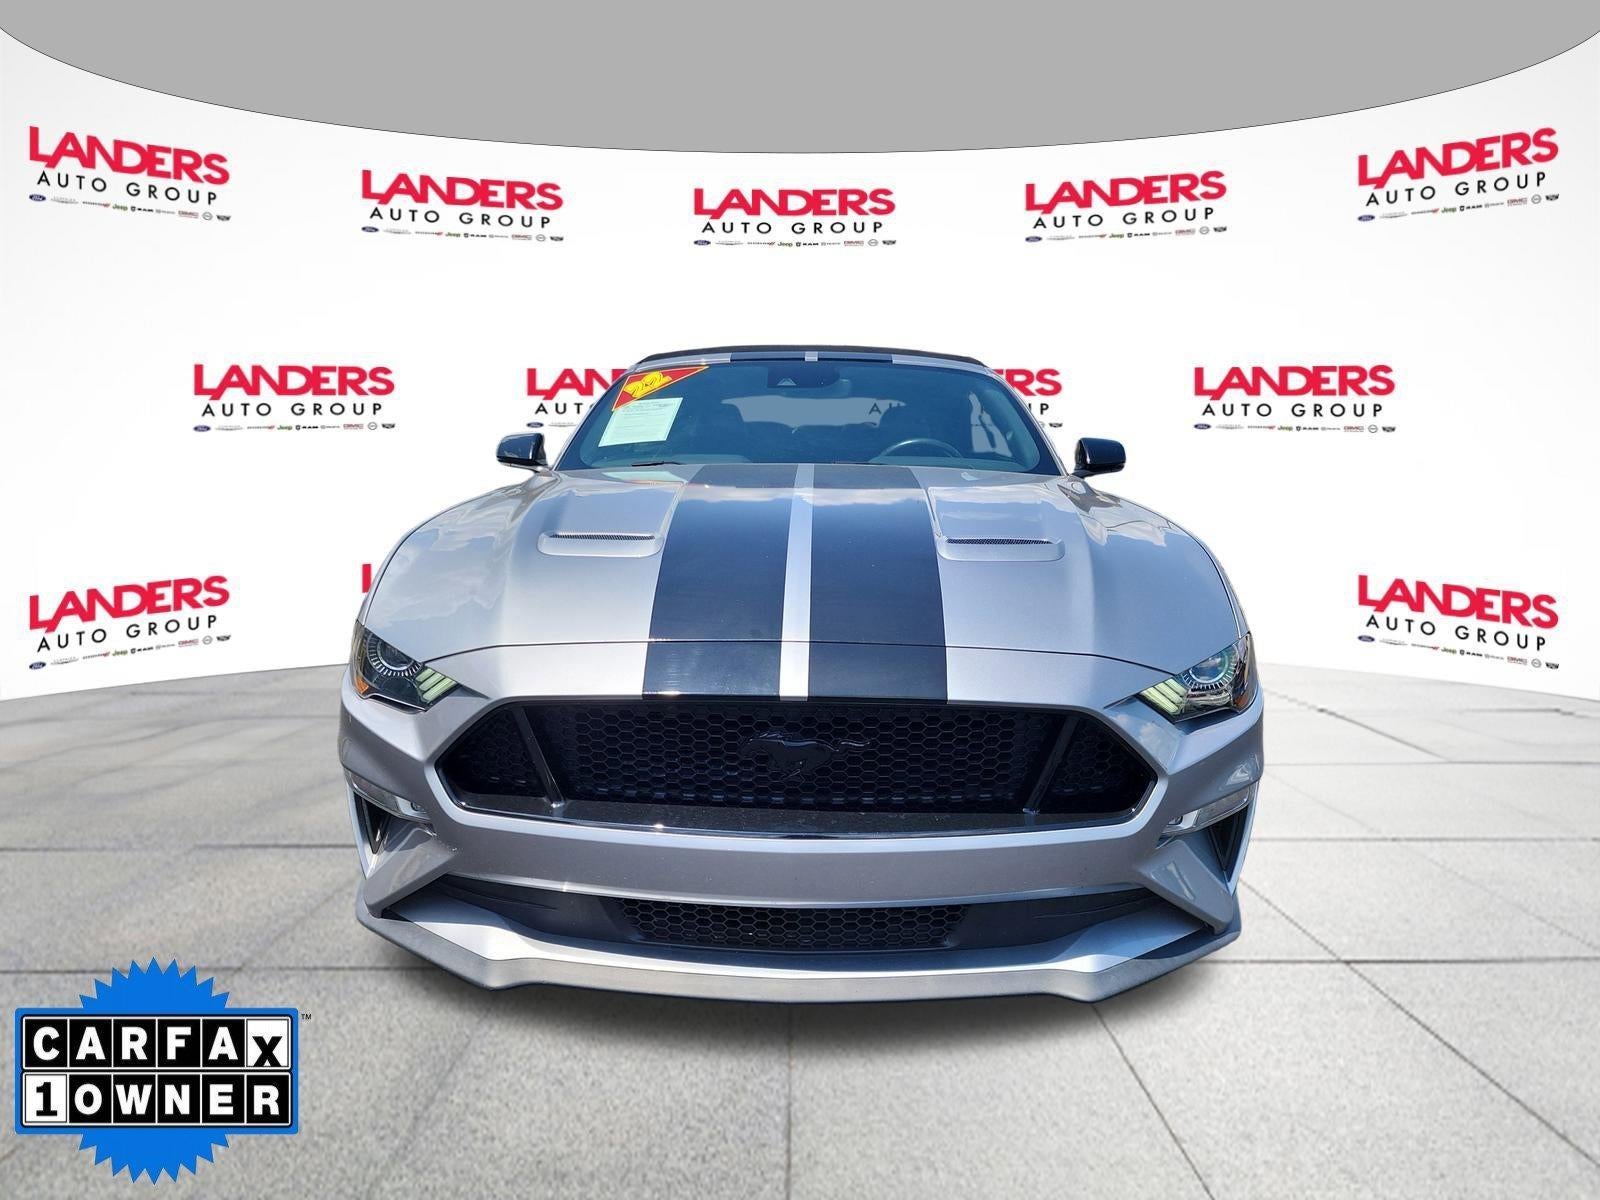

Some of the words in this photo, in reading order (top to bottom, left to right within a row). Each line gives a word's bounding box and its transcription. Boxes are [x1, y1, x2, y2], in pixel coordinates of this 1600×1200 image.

[30, 126, 230, 185] LANDERS
[1358, 128, 1559, 190] LANDERS
[37, 170, 107, 192] AUTO
[126, 182, 217, 205] GROUP
[362, 170, 564, 211] LANDERS
[694, 189, 896, 220] LANDERS
[1026, 171, 1227, 215] LANDERS
[1366, 185, 1436, 207] AUTO
[1455, 171, 1546, 196] GROUP
[370, 206, 440, 223] AUTO
[459, 212, 550, 229] GROUP
[701, 221, 772, 234] AUTO
[791, 221, 883, 235] GROUP
[1033, 214, 1103, 229] AUTO
[1122, 207, 1214, 225] GROUP
[194, 364, 395, 401] LANDERS
[1195, 365, 1396, 401] LANDERS
[201, 402, 272, 417] AUTO
[290, 402, 382, 416] GROUP
[534, 402, 594, 415] AUT
[1202, 403, 1272, 417] AUTO
[1291, 403, 1383, 417] GROUP
[30, 576, 230, 633] LANDERS
[1358, 575, 1559, 629] LANDERS
[37, 628, 107, 653] AUTO
[126, 614, 217, 638] GROUP
[1366, 614, 1436, 636] AUTO
[1455, 625, 1546, 651] GROUP
